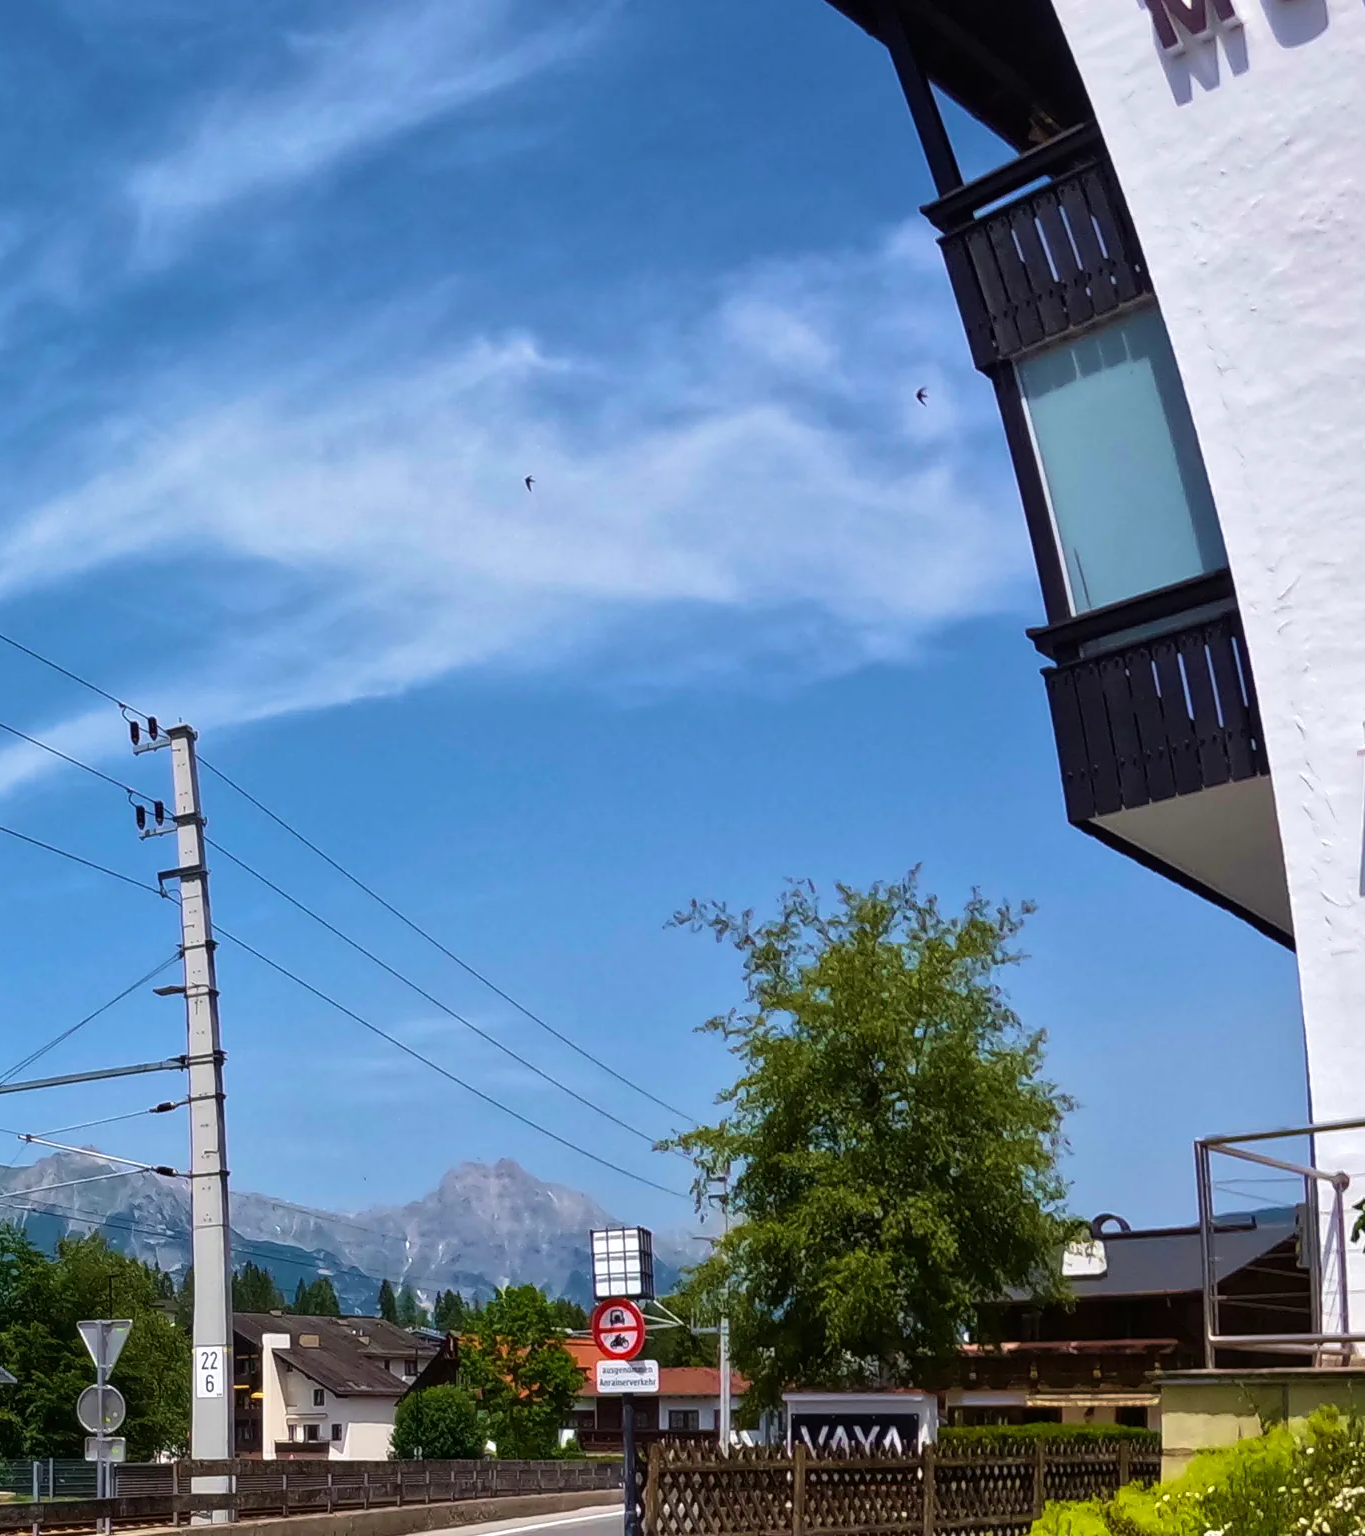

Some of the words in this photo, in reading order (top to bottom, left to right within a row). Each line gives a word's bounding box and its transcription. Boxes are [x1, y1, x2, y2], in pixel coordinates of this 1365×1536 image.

[201, 1351, 218, 1370] 22
[205, 1374, 215, 1393] 6
[600, 1377, 656, 1387] Anrainerverkehr
[799, 1425, 904, 1461] VAYA
